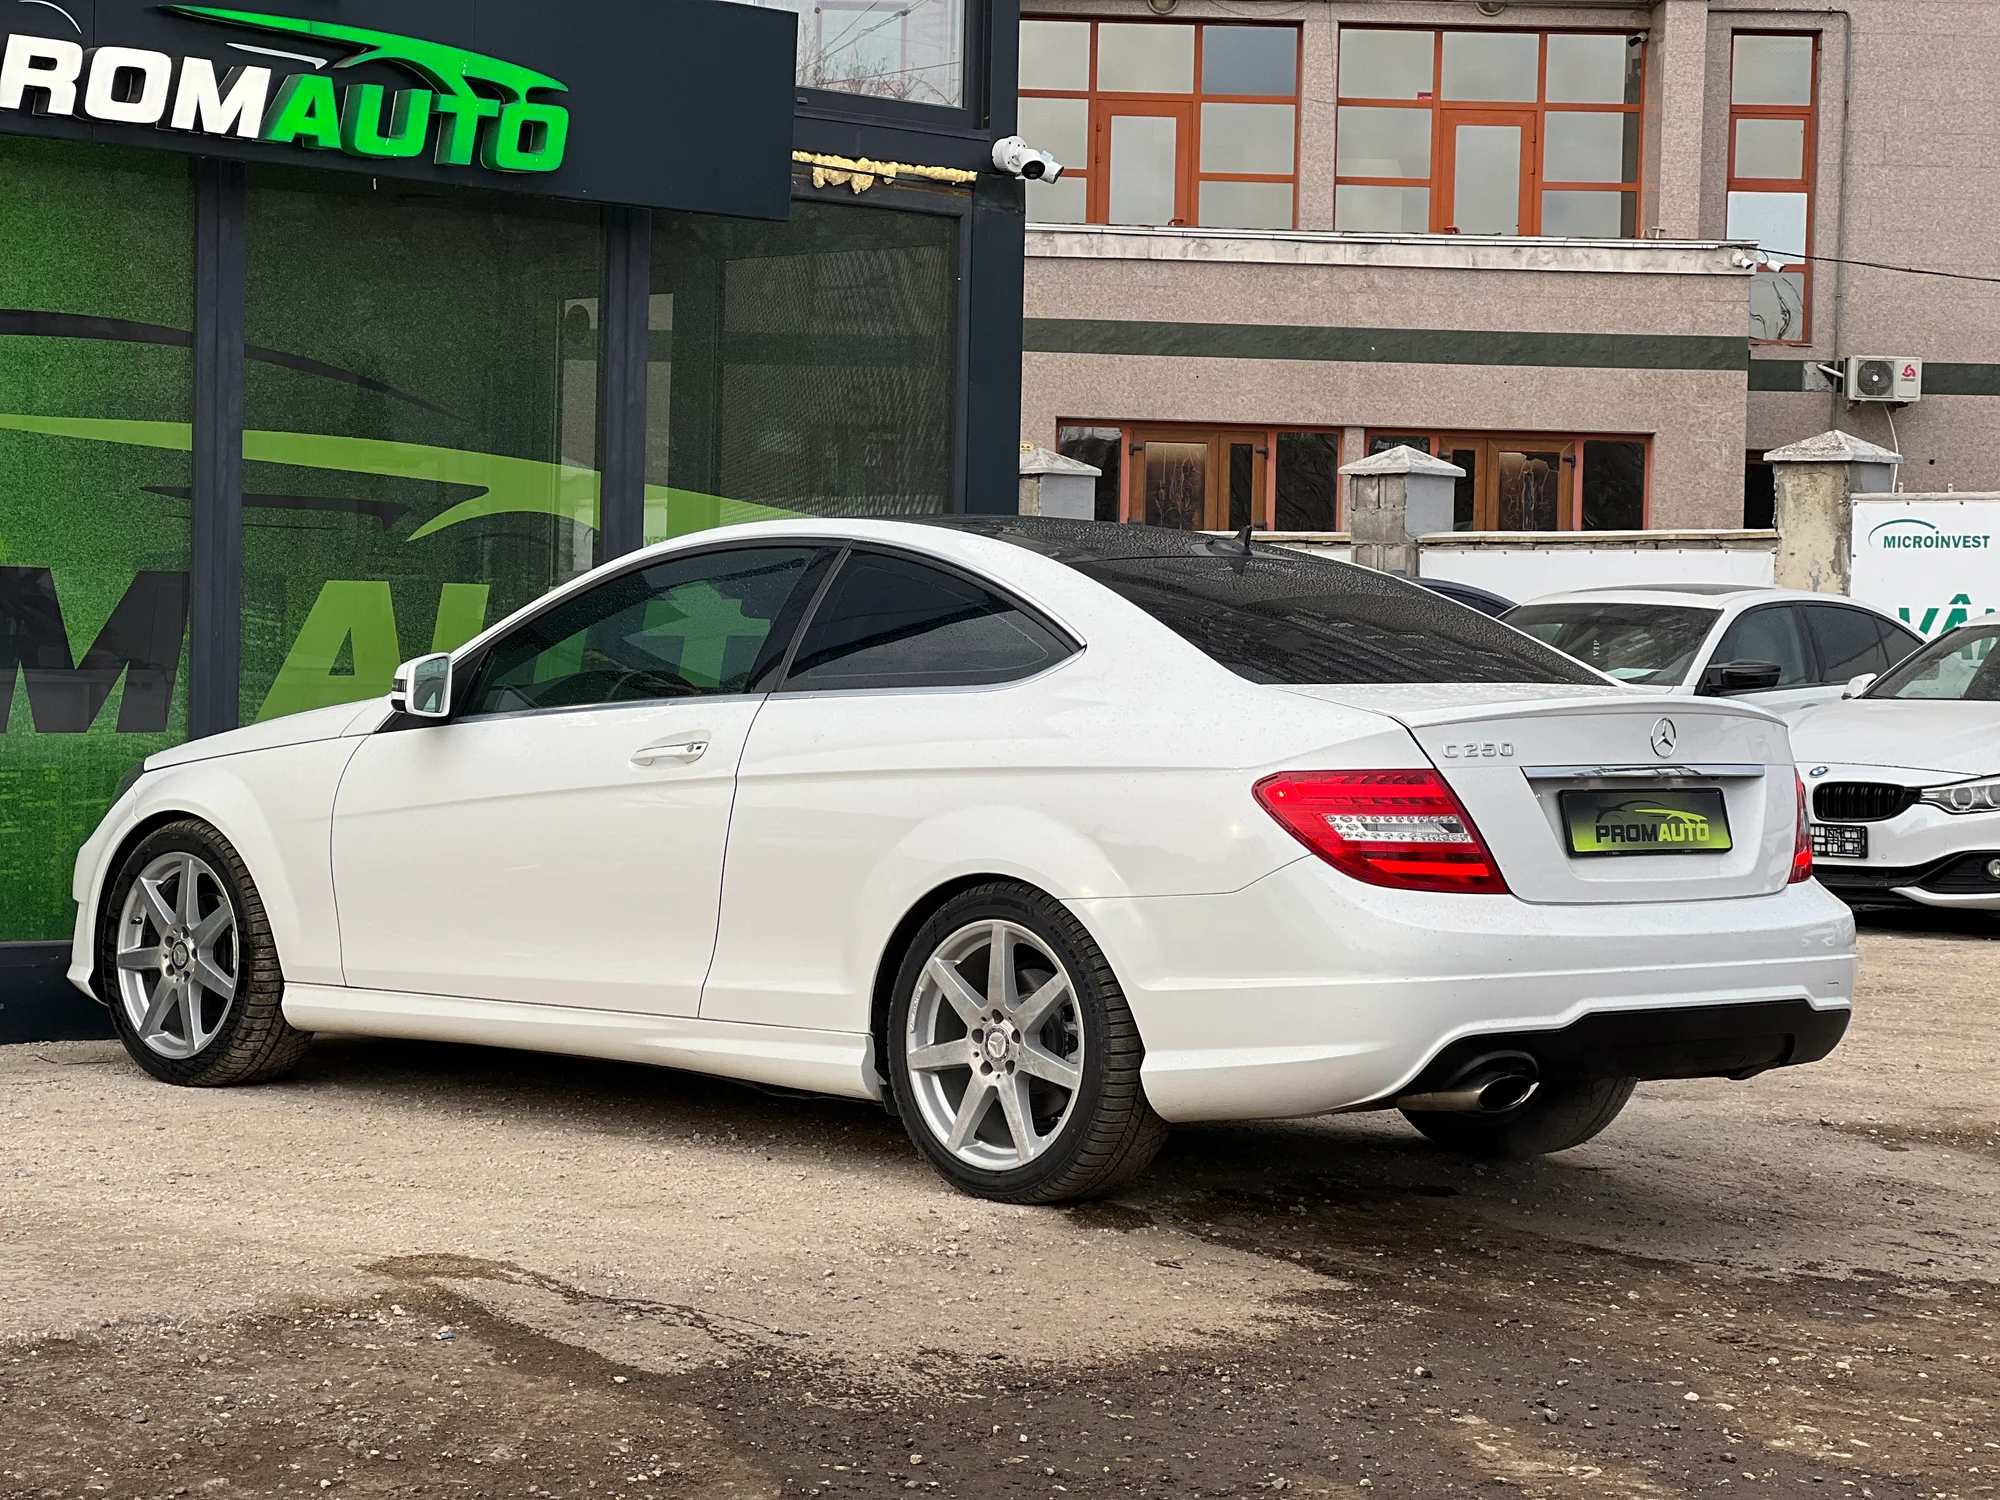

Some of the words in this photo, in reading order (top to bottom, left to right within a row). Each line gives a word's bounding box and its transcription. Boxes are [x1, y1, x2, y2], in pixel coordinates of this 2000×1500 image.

[1443, 743, 1459, 758] C
[1464, 741, 1514, 758] 250
[1595, 823, 1710, 843] PROMAUTO
